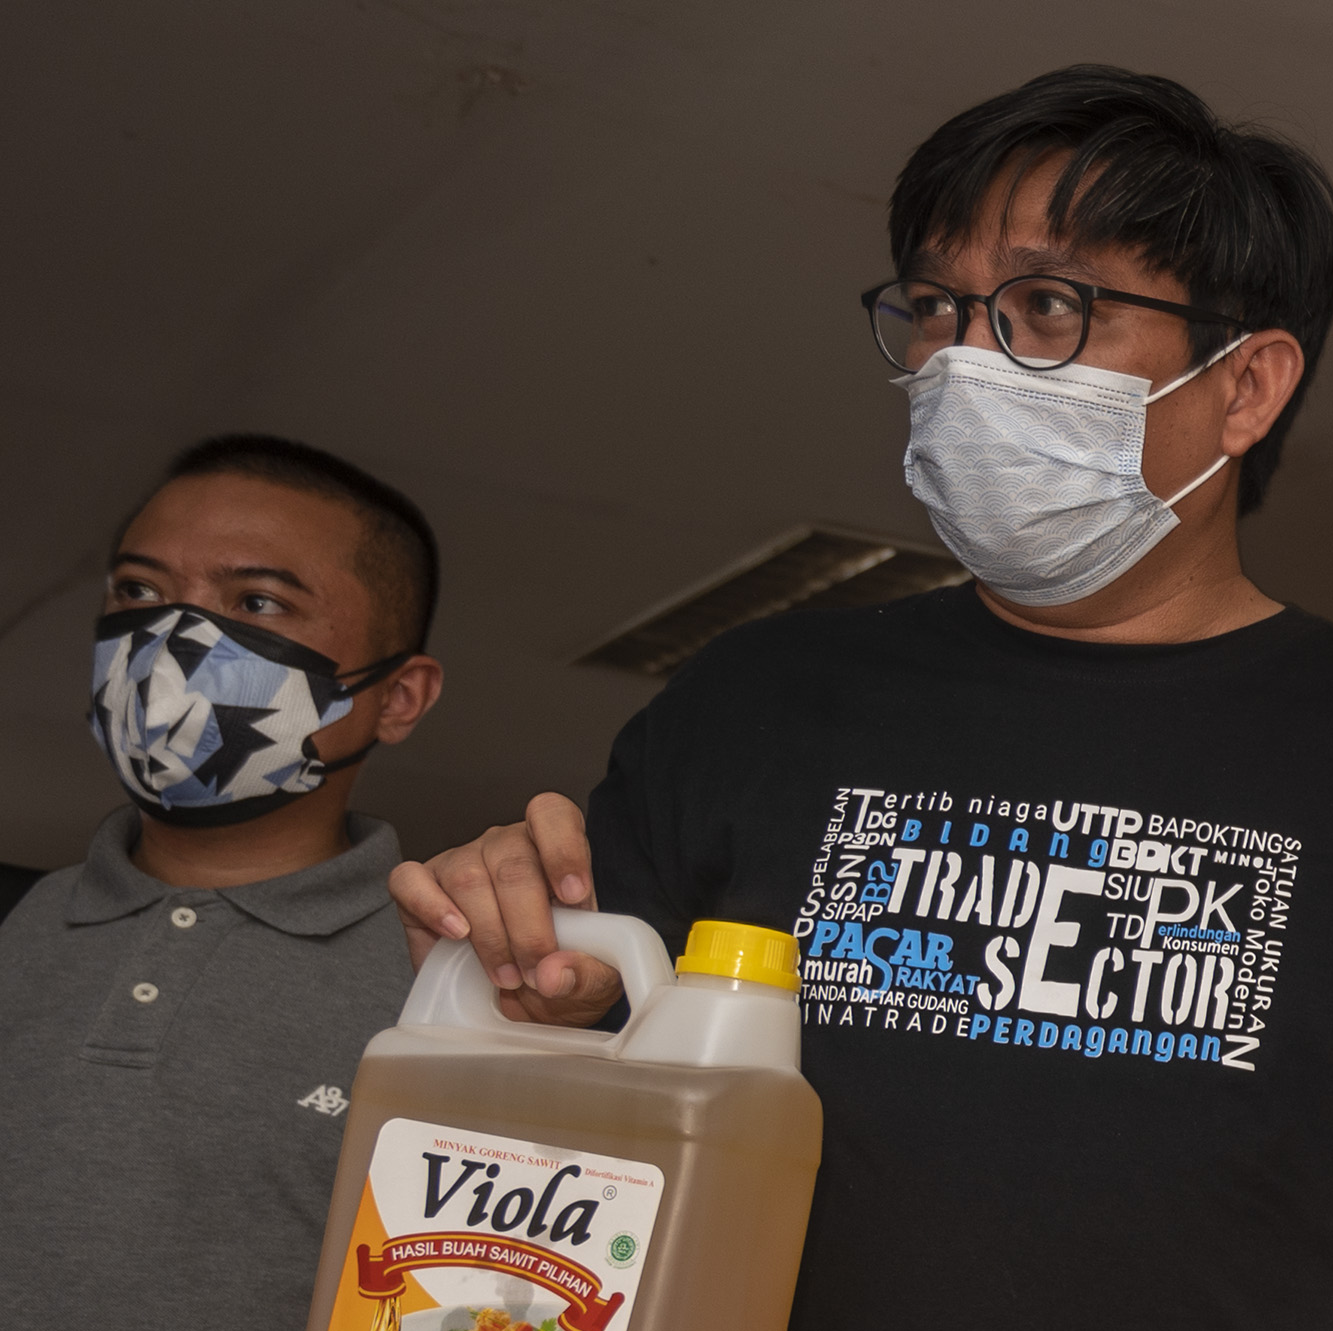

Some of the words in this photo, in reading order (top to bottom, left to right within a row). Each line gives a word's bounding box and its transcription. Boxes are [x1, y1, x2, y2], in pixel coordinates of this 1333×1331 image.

[852, 788, 954, 833] Tertib
[969, 796, 1048, 823] niaga
[1052, 801, 1144, 839] UTTP
[838, 833, 896, 846] P3DN
[822, 902, 883, 922] SIPAP
[887, 847, 1106, 1018] TRADE
[1162, 936, 1240, 955] Konsumen
[805, 959, 873, 984] murah
[896, 967, 980, 995] RAKYAT
[1229, 930, 1266, 1028] Modern
[802, 984, 847, 1001] TANDA
[850, 987, 905, 1007] DAFTAR
[907, 993, 969, 1014] GUDANG
[433, 1139, 476, 1155] MINYAK
[479, 1148, 525, 1164] GORENG
[527, 1156, 561, 1170] SAWIT
[422, 1152, 599, 1246] Viola
[392, 1241, 439, 1261] HASIL
[442, 1241, 486, 1258] BUAH
[489, 1246, 539, 1270] SAWIT
[537, 1263, 593, 1298] PILIHAN
